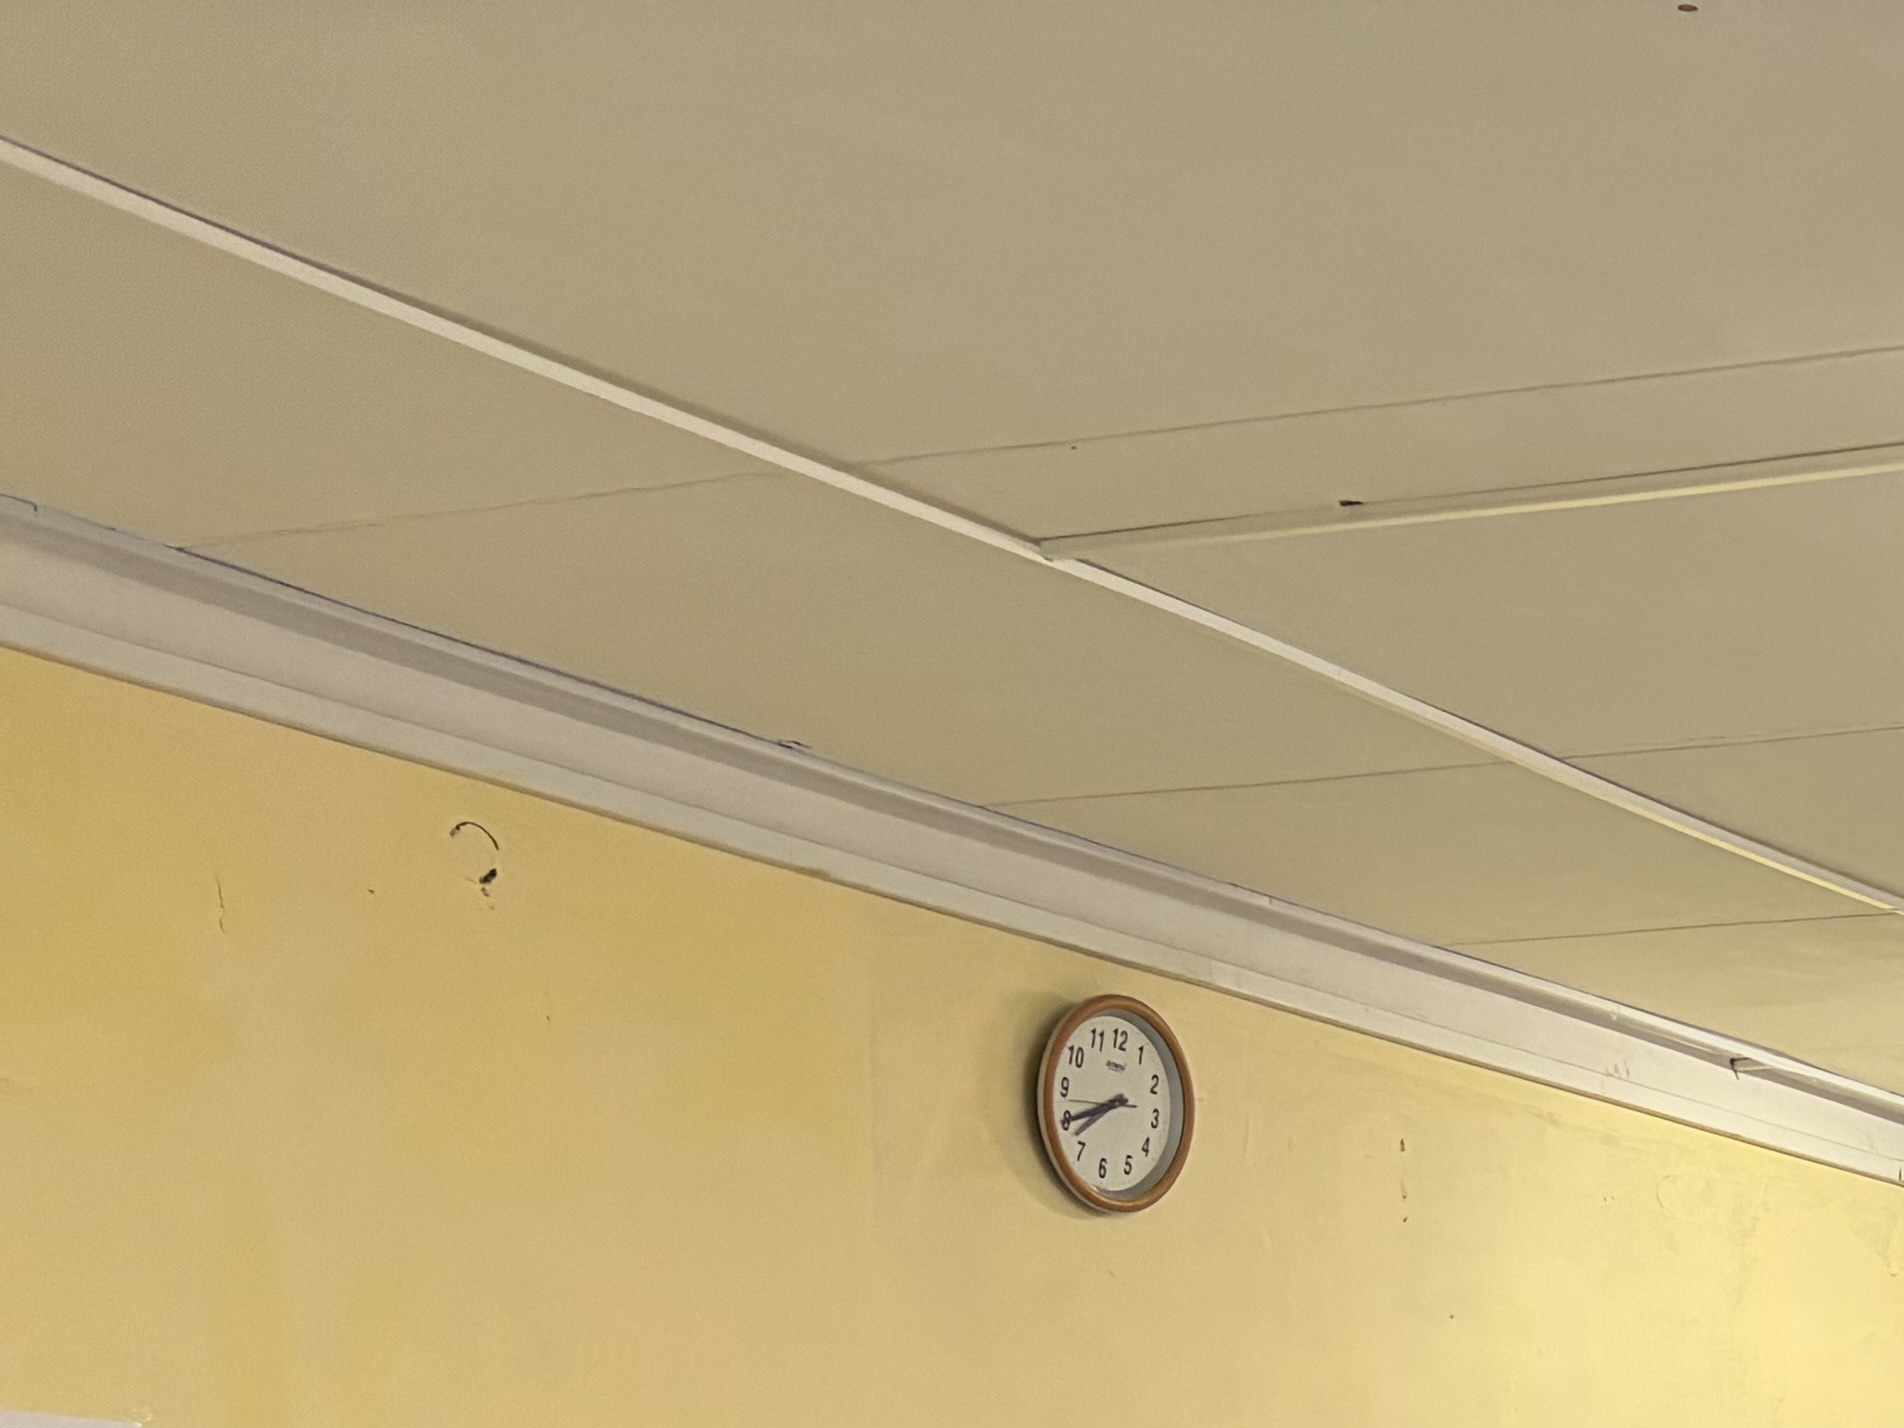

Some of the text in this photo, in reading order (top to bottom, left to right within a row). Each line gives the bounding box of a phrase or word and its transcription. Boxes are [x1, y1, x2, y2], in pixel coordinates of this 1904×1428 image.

[1091, 1029, 1105, 1052] 11
[1113, 1029, 1128, 1051] 12
[1068, 1045, 1084, 1068] 10
[1138, 1046, 1144, 1065] 1
[1061, 1077, 1069, 1098] 9
[1150, 1074, 1158, 1095] 2
[1062, 1110, 1072, 1130] 8
[1151, 1109, 1159, 1129] 3
[1077, 1141, 1086, 1161] 7
[1142, 1137, 1150, 1157] 4
[1099, 1158, 1107, 1179] 6
[1124, 1155, 1132, 1175] 5
